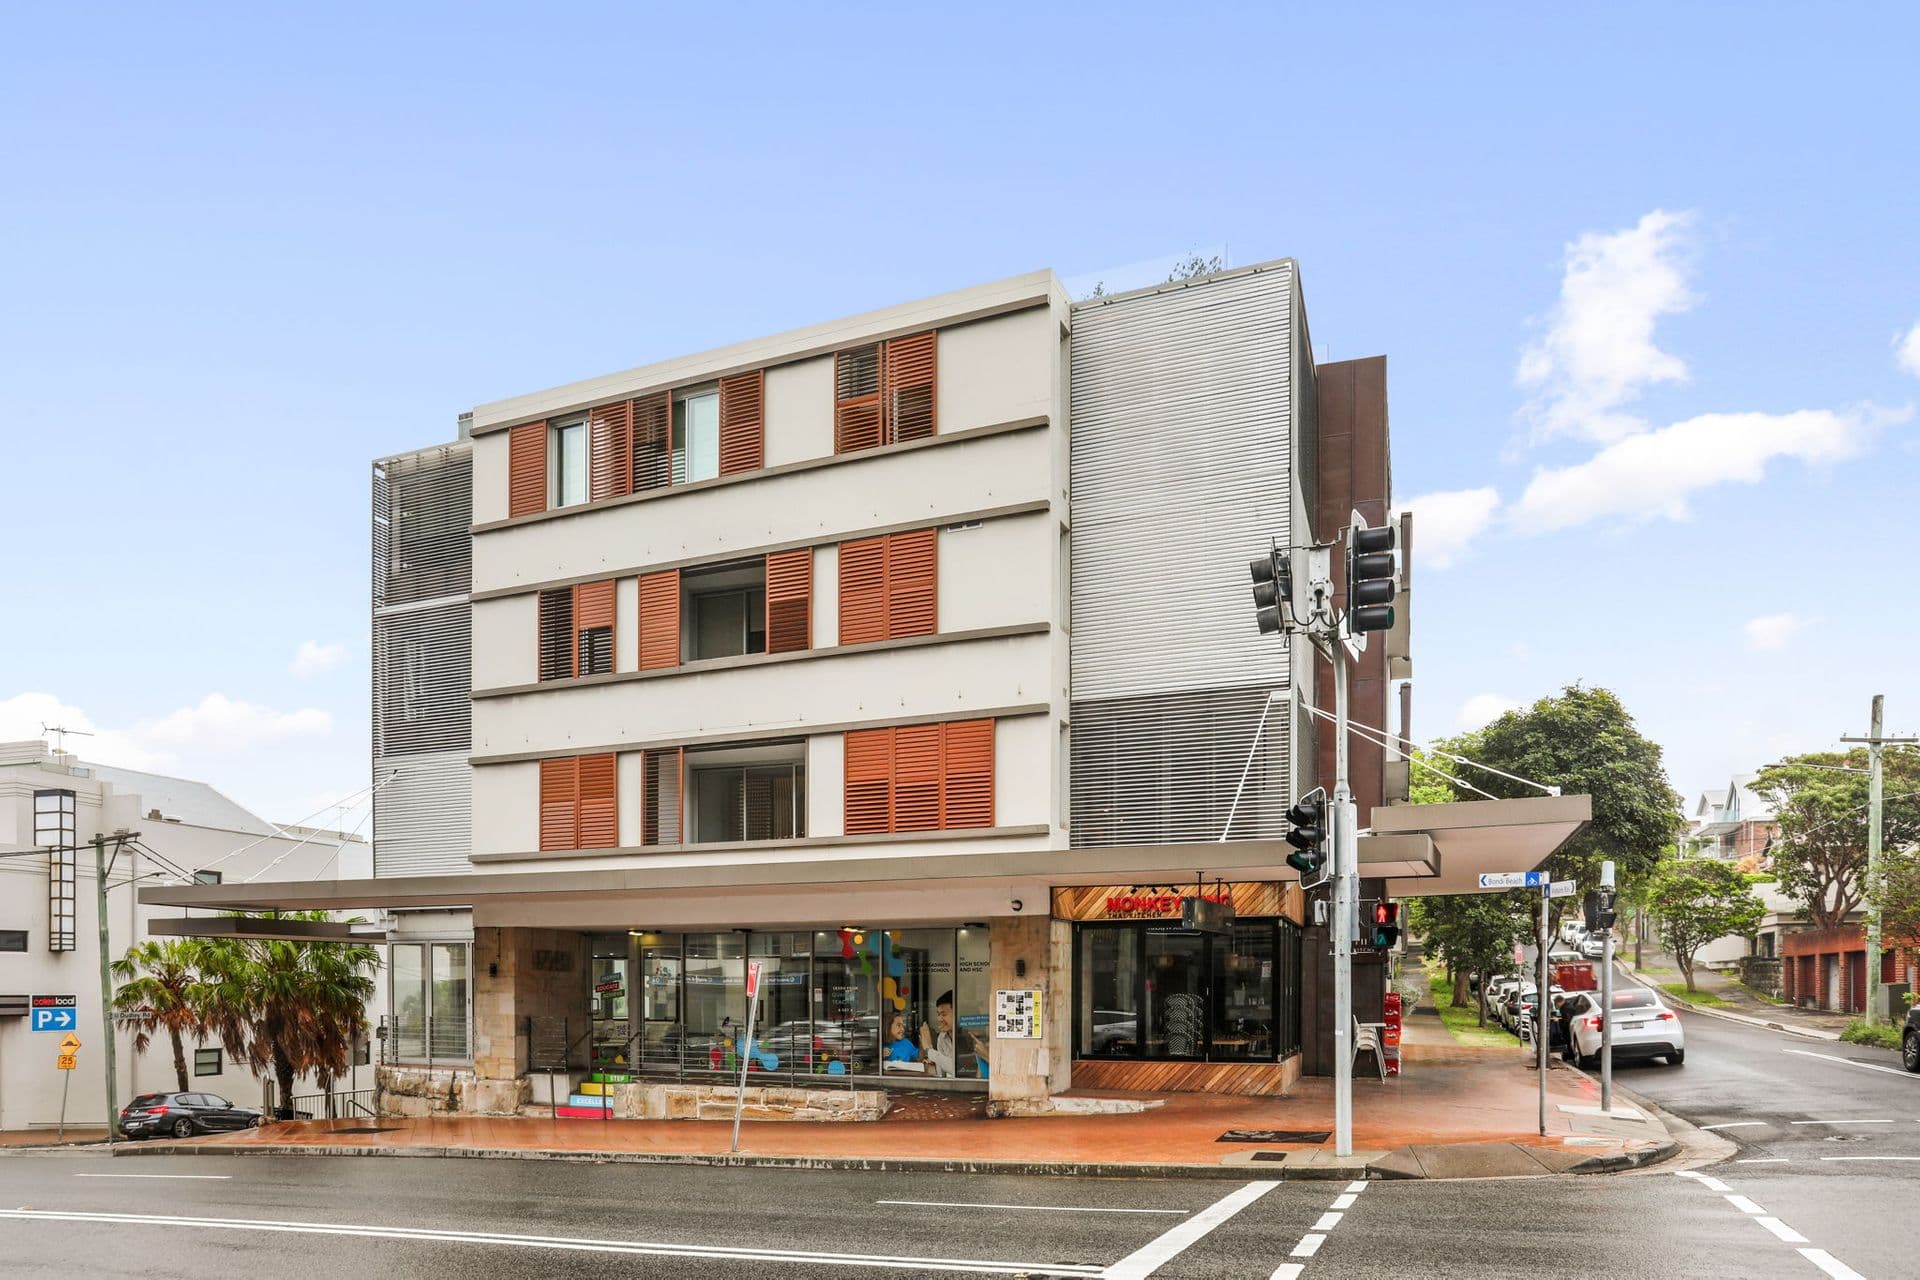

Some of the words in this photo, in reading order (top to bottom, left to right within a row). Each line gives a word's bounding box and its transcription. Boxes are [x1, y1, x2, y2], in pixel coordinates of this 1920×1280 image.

[1505, 877, 1523, 885] Beach
[1107, 896, 1184, 912] MONKEY
[38, 1011, 53, 1028] P
[61, 1056, 73, 1065] 25
